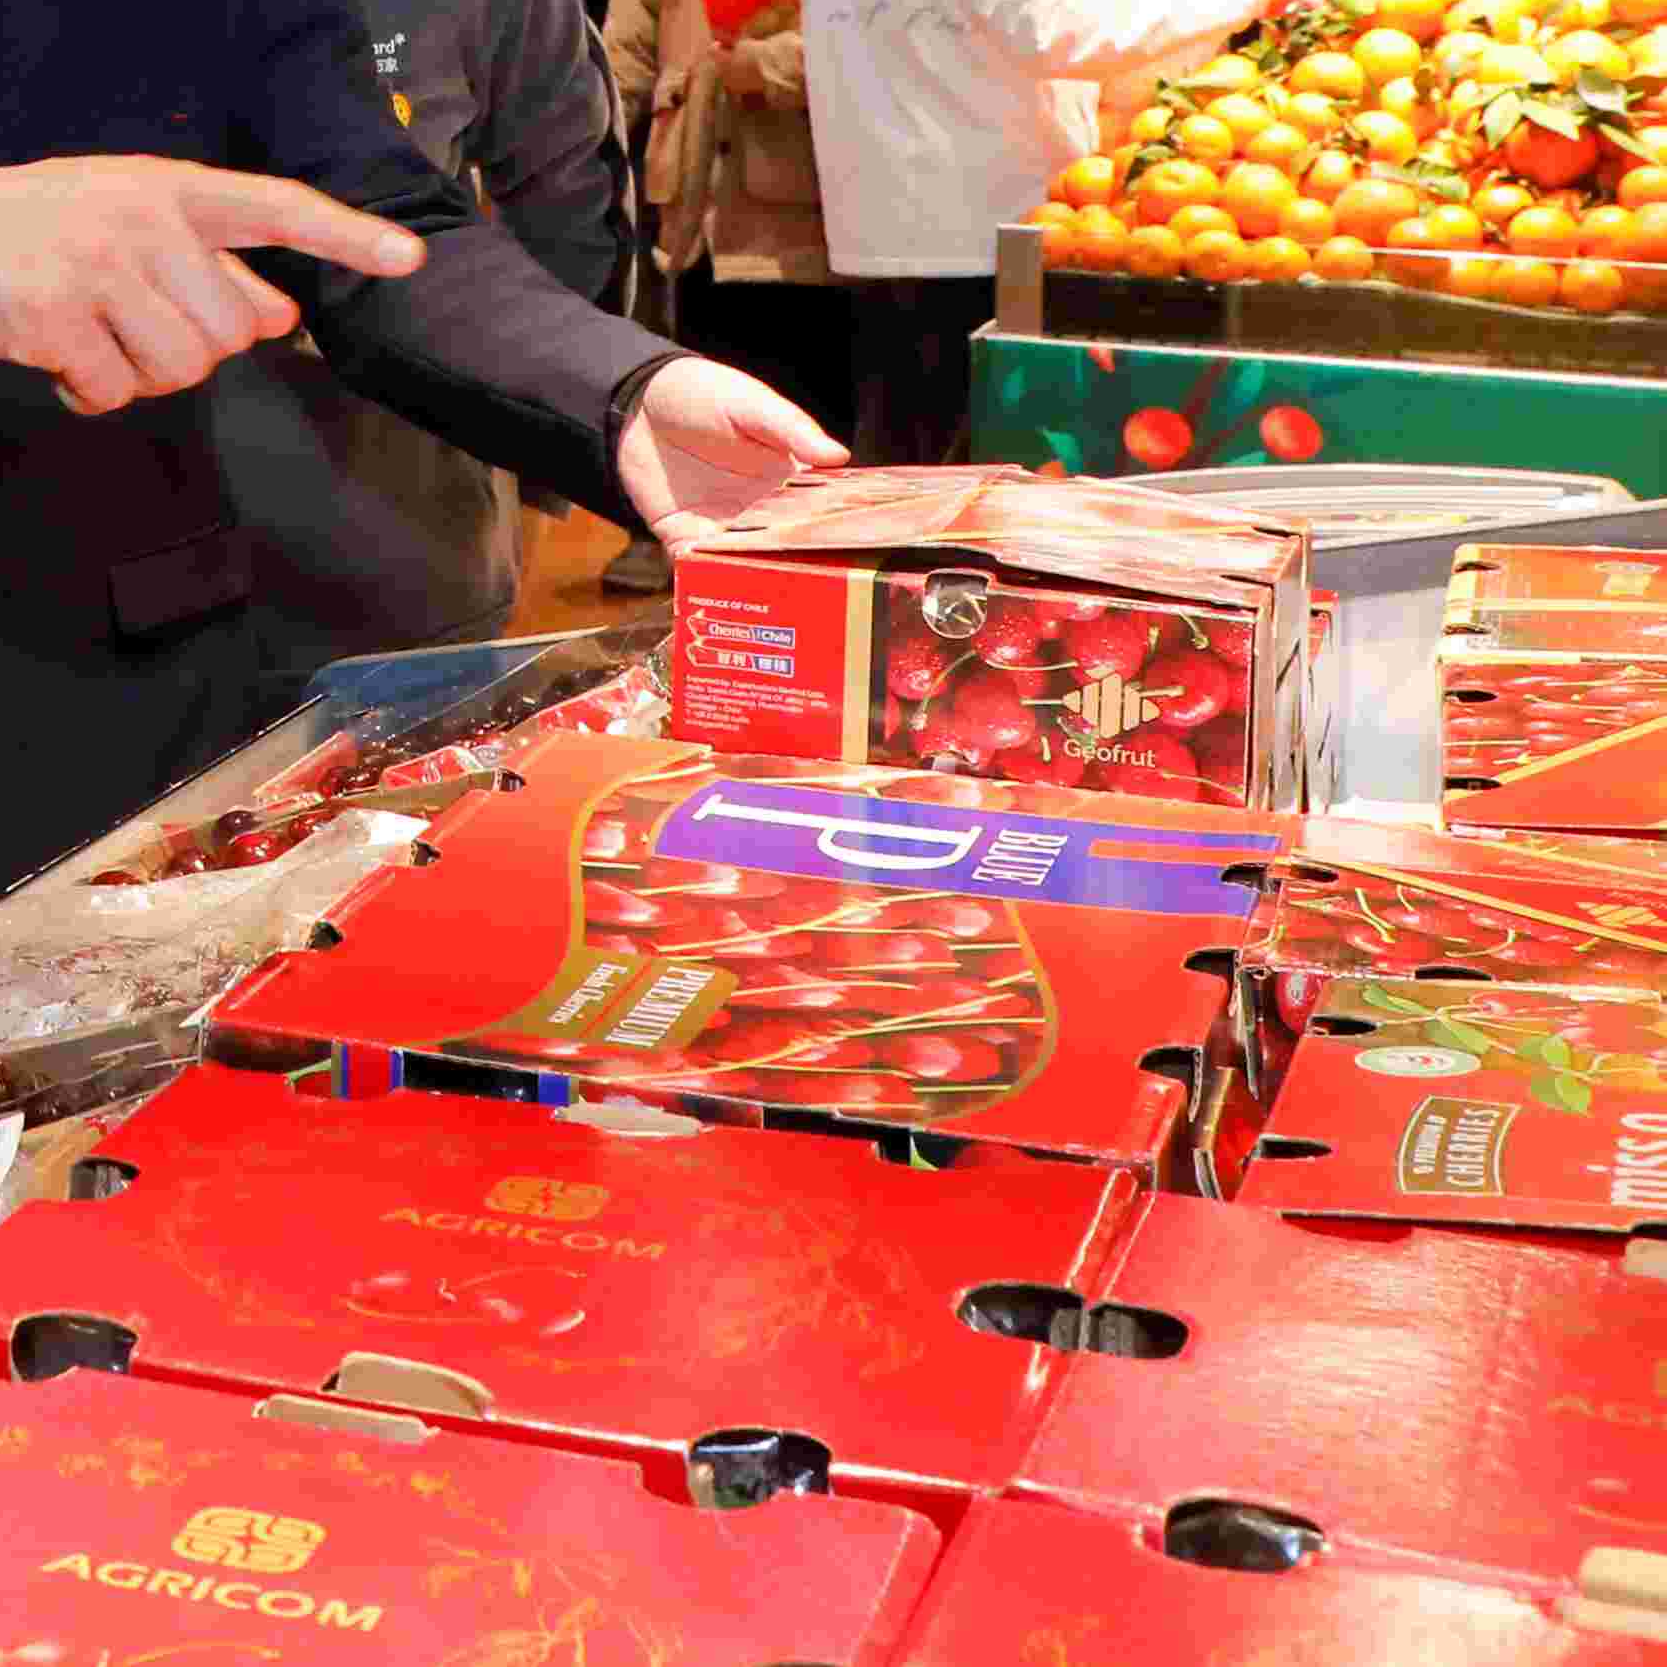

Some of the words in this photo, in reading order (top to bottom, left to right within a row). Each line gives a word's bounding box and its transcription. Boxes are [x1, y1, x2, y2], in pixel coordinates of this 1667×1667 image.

[1064, 738, 1157, 768] Geofrut
[970, 828, 1069, 888] BLUE
[603, 965, 716, 1048] PREMIUM
[1445, 1109, 1503, 1188] CHERRIES
[378, 1206, 668, 1261] AGRICOM
[38, 1550, 384, 1633] AGRICOM
